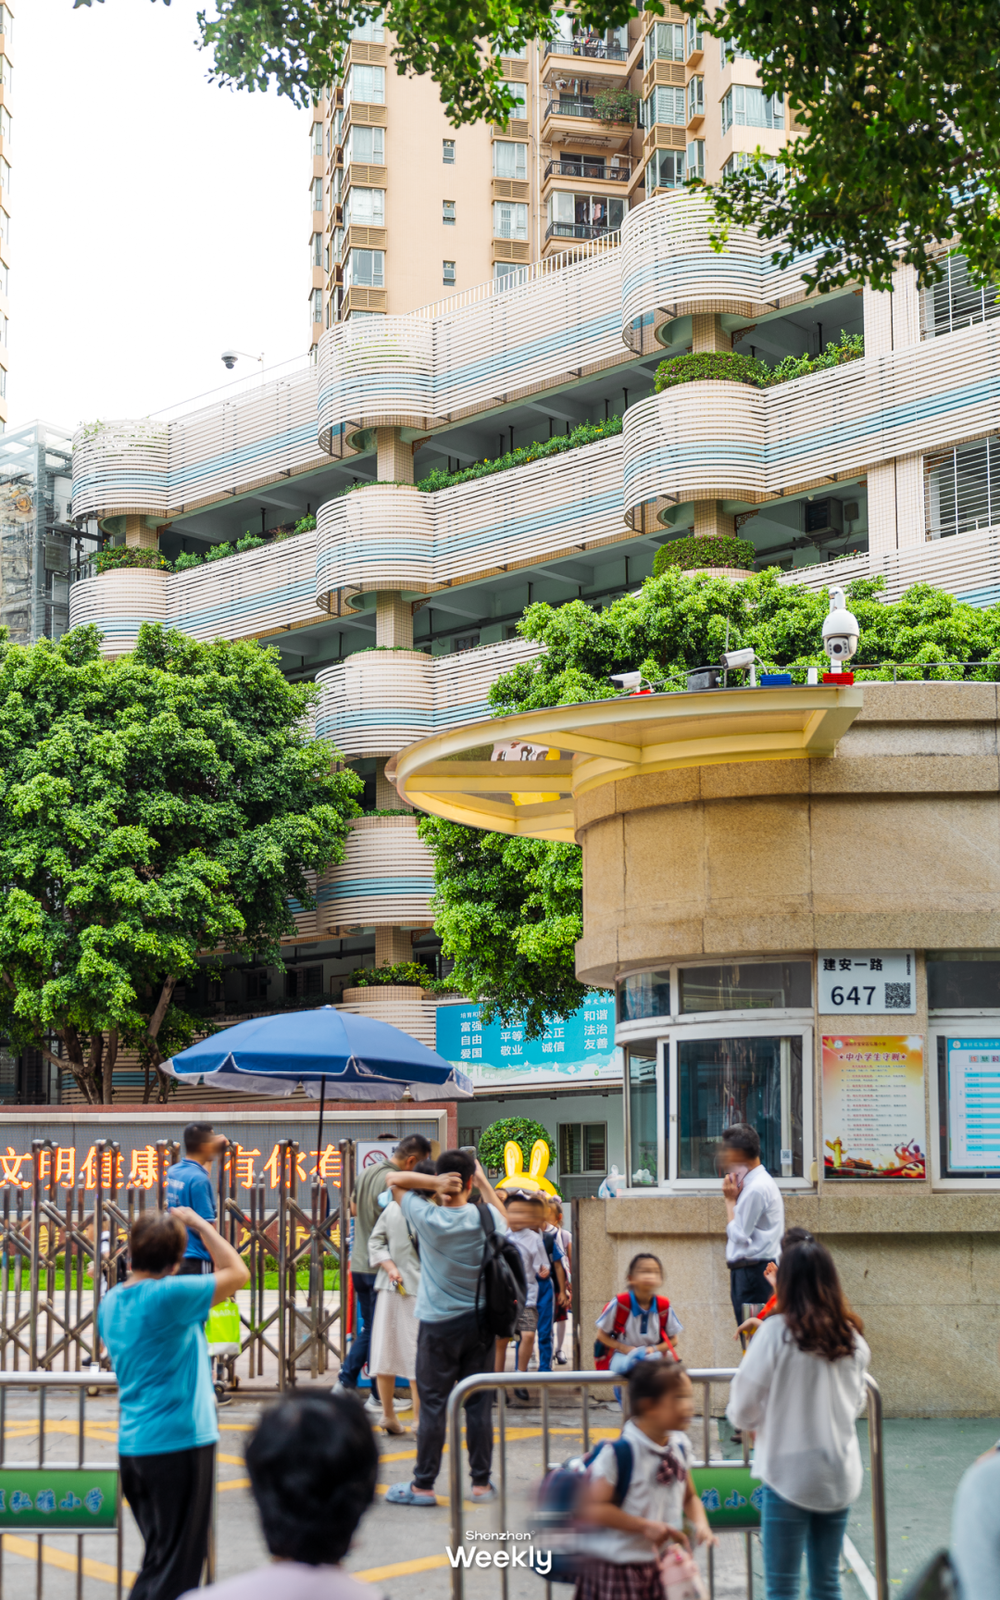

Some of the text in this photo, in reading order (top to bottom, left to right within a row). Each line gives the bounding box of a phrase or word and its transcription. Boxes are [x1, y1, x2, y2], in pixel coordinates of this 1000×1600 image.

[823, 958, 883, 971] 建安一路
[831, 985, 877, 1006] 647
[460, 1020, 482, 1032] 富强
[584, 1009, 608, 1021] 和谐
[461, 1023, 608, 1046] 自由 平等 公正 法治
[460, 1037, 608, 1059] 爱国 敬业 诚信 友善
[845, 1052, 901, 1062] 中小学生守则
[0, 1146, 171, 1191] 文明健康
